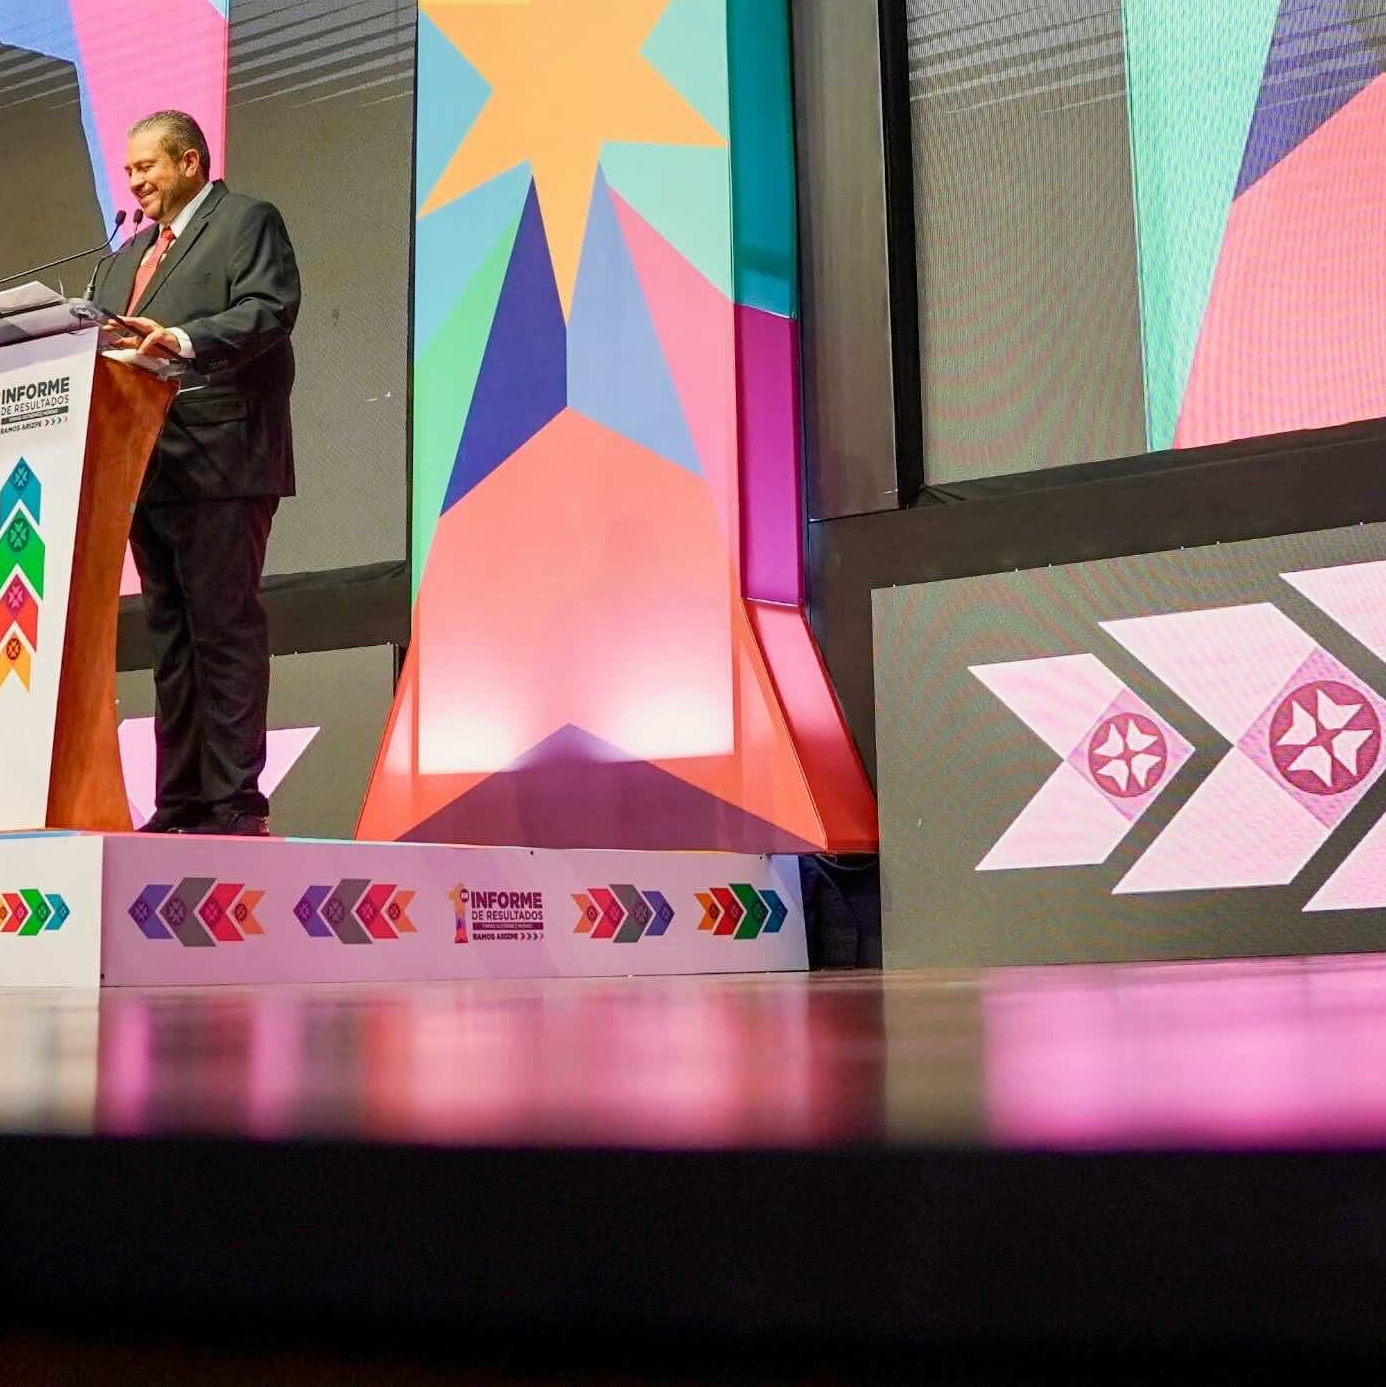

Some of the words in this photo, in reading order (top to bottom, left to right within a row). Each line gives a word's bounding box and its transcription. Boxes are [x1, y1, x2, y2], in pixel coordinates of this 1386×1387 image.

[1, 376, 70, 405] INFORME
[0, 405, 12, 416] DE
[14, 394, 69, 413] RESULTADOS
[470, 891, 543, 909] INFORME
[472, 911, 484, 920] DE
[486, 910, 543, 920] RESULTADOS
